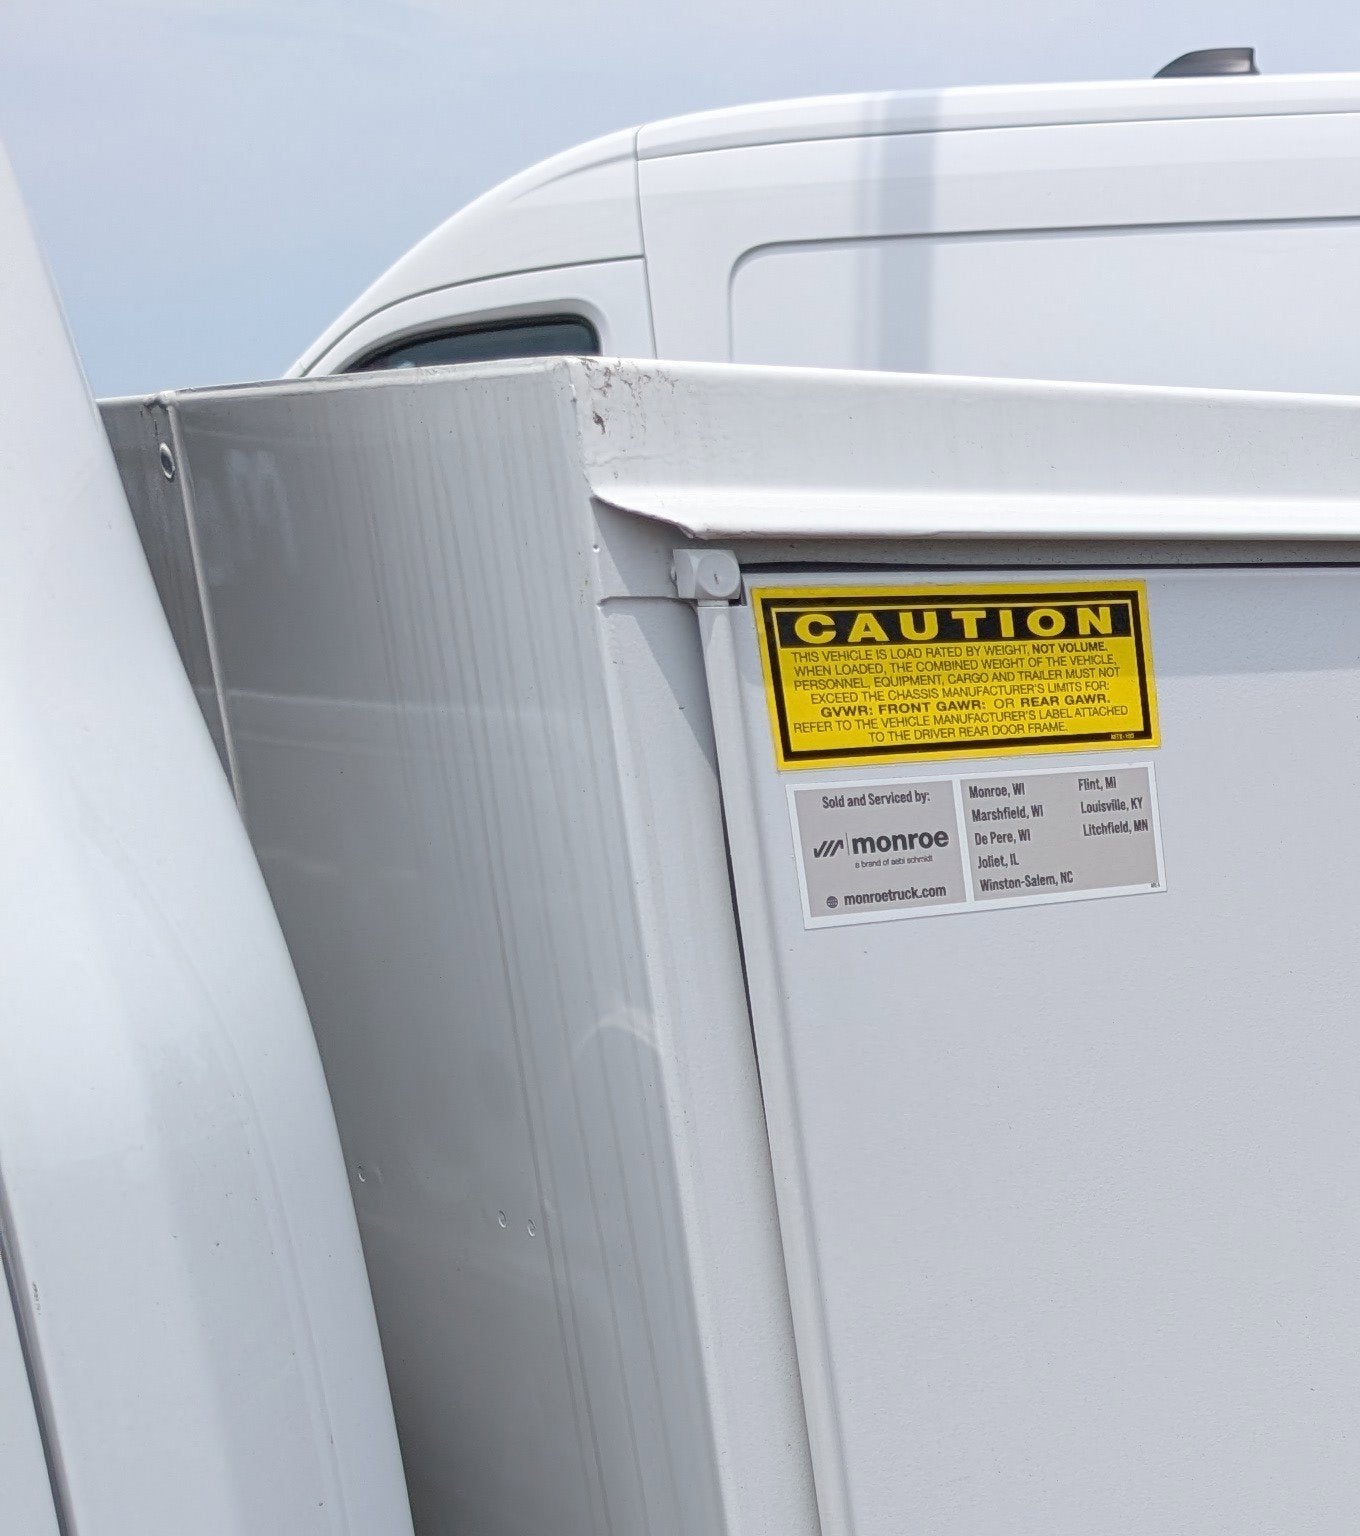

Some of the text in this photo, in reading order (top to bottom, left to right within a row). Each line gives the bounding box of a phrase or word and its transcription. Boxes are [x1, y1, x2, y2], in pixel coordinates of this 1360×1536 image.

[794, 607, 1113, 644] CAUTION
[792, 642, 1108, 663] THIS VEHICLE IS LOAD RATED BY WEIGHT, NOT VOLUME.
[794, 654, 1117, 677] WHEN LOADED, THE COMBINED WEIGHT OF THE VEHICLE,
[794, 667, 1120, 691] PERSONNEL, EQUIPMENT, CARGO AND TRAILER MUST NOT
[811, 680, 1109, 704] EXCEED THE CHASSIS MANUFACTURER'S LIMITS FOR:
[820, 694, 1111, 718] GVWR: FRONT GAWR: OR REAR GAWR.
[794, 705, 1128, 733] REFER TO THE VEHICLE MANUFACTURER'S LABEL ATTACHED
[868, 722, 1067, 742] TO THE DRIVER REAR DOOR FRAME.
[969, 783, 1025, 798] Monroe, WI
[1078, 777, 1117, 791] Flint, MI
[822, 790, 930, 809] Sold and Serviced by:
[1081, 797, 1143, 814] Louisville, KY
[972, 804, 1044, 822] Marshfield, WI
[975, 829, 1031, 845] De Pere, WI
[1083, 819, 1148, 836] Litchfield, MN
[852, 831, 949, 854] monroe
[861, 859, 881, 867] brand
[977, 853, 1019, 869] Joliet, IL
[980, 871, 1073, 892] Winston-Salem, NC
[845, 886, 947, 906] monroetruck.com
